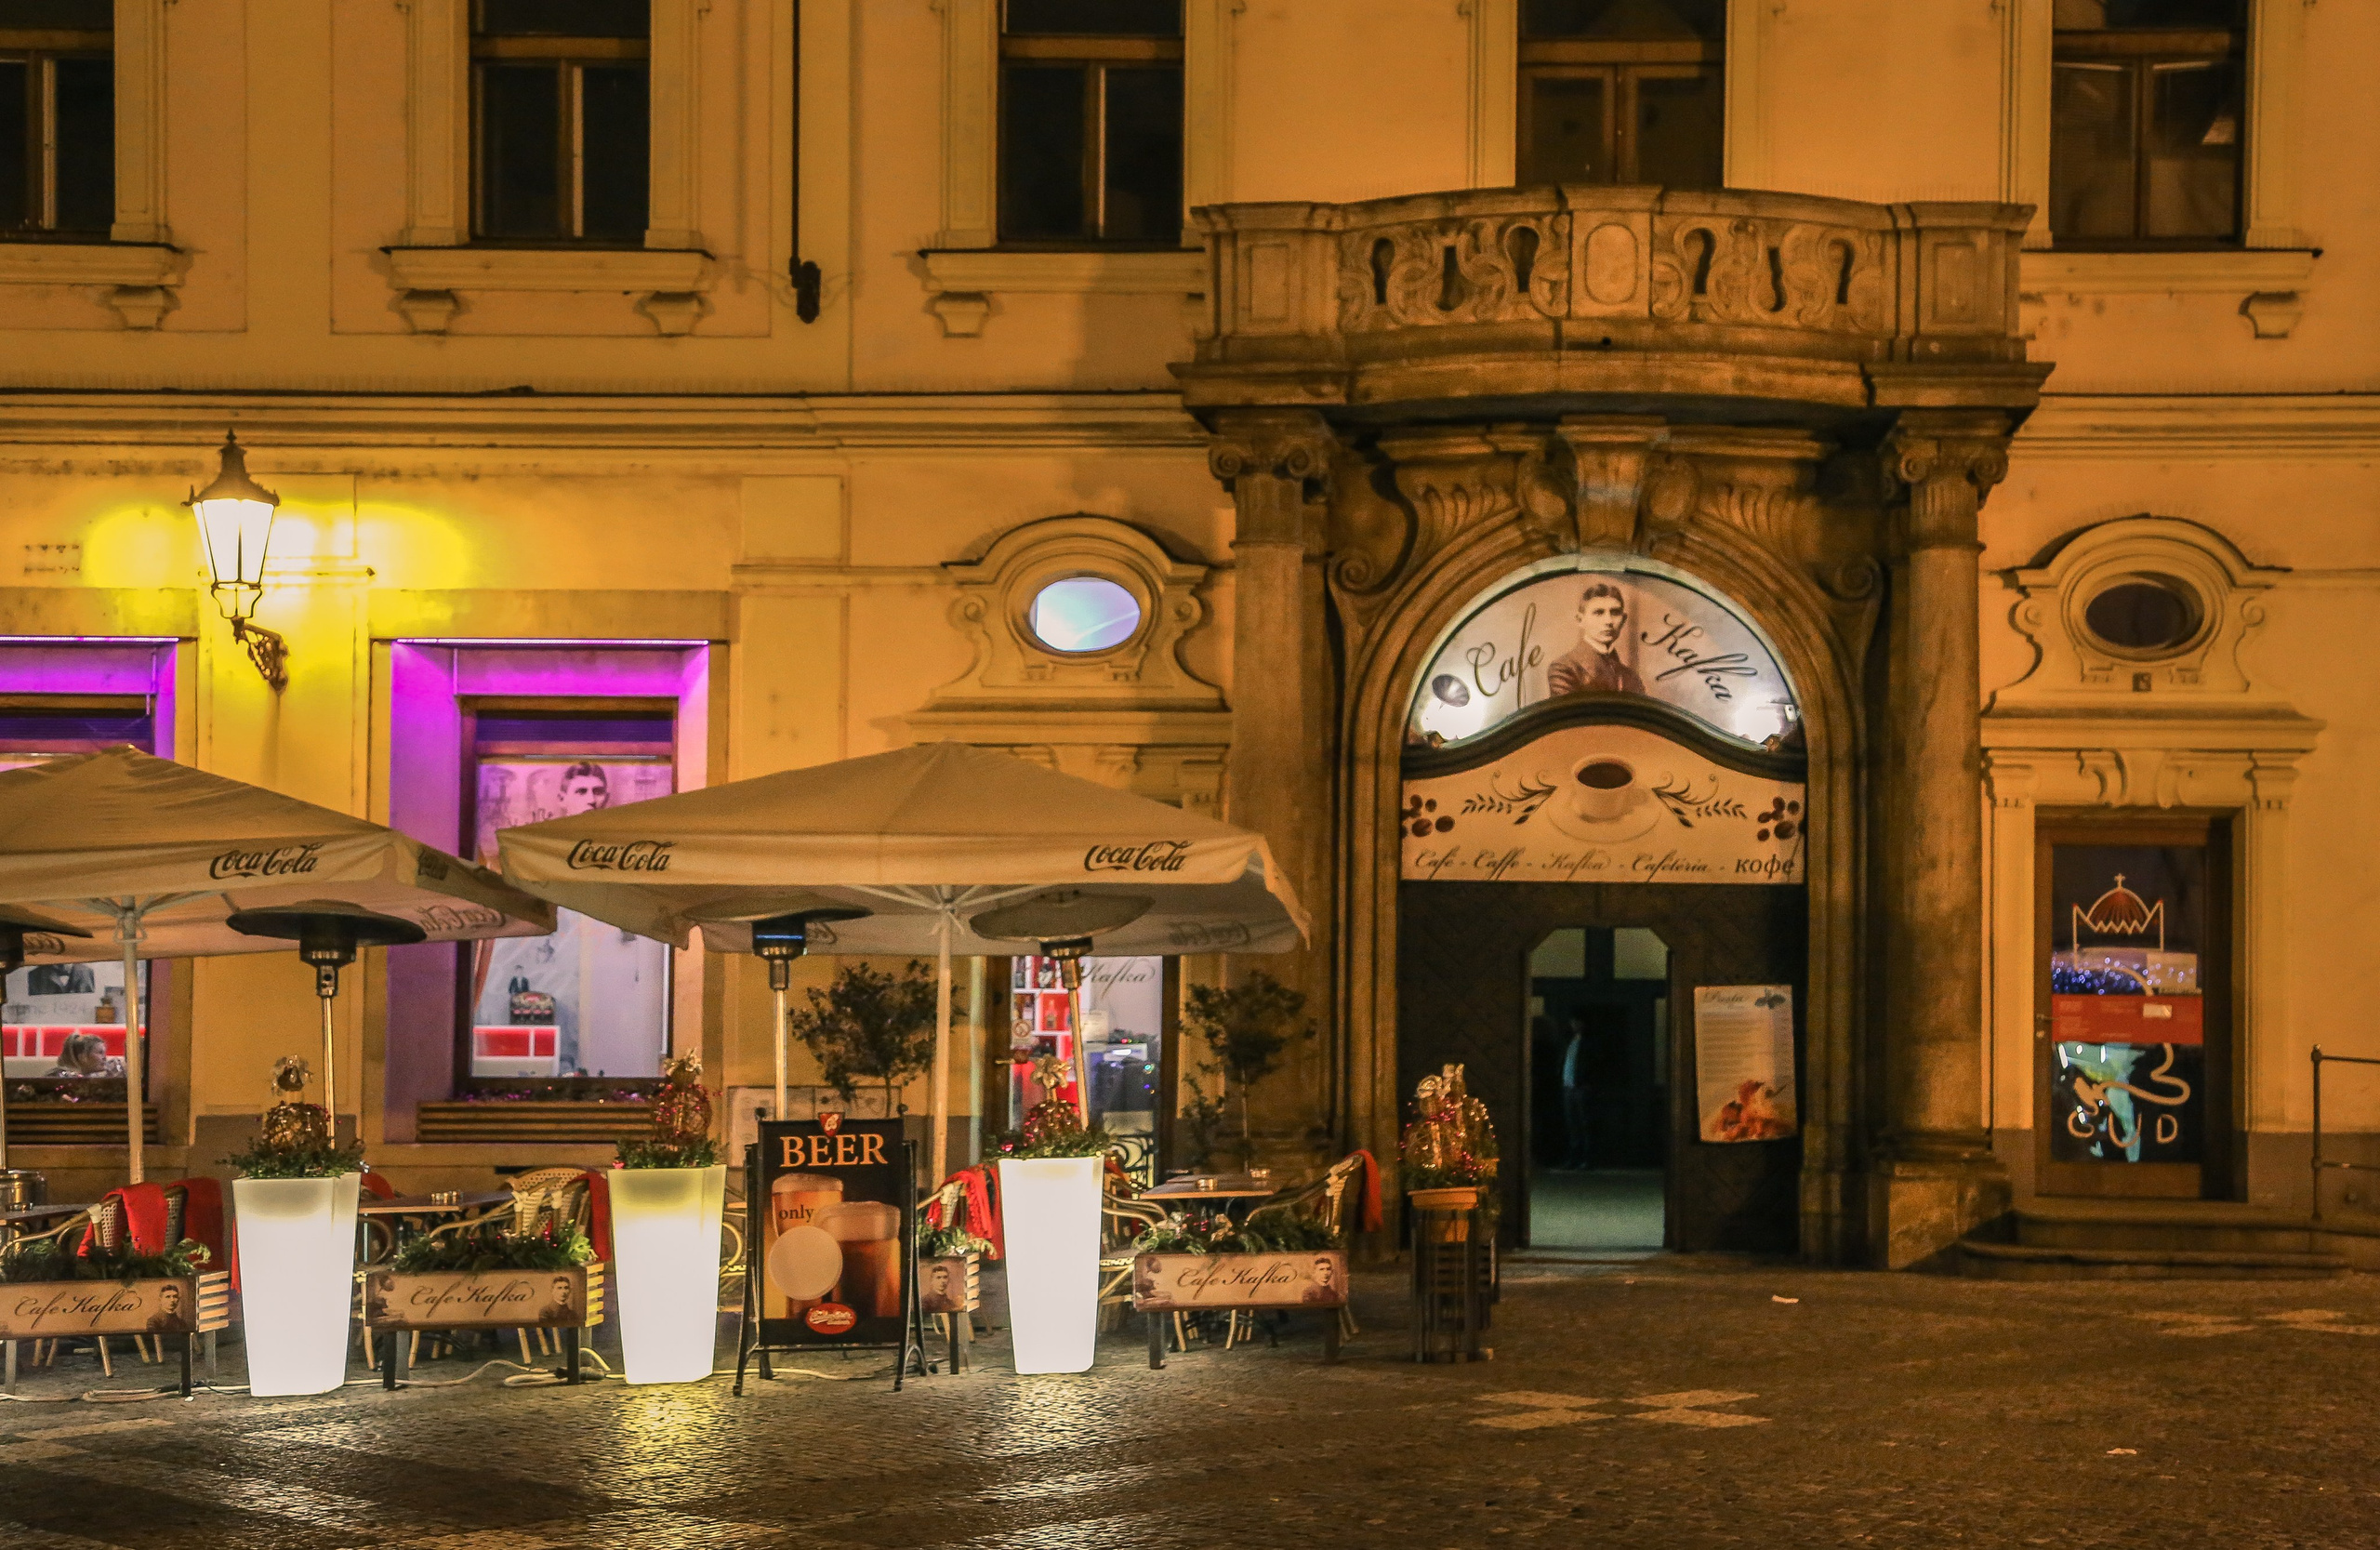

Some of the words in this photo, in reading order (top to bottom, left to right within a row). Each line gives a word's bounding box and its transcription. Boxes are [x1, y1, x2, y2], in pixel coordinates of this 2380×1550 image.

[1466, 602, 1544, 709] Cafe
[1641, 614, 1758, 701] Kafka
[209, 841, 324, 880] Coca-Cola
[566, 839, 678, 871] Coca-Cola
[1083, 840, 1196, 872] Coca-Cola
[1541, 847, 1612, 881] Kafka
[779, 1133, 889, 1168] BEER
[778, 1204, 814, 1224] only
[410, 1279, 463, 1318] Cafe
[456, 1278, 536, 1318] Kafka
[1176, 1262, 1226, 1301] Cafe
[1222, 1260, 1298, 1299] Kafka
[14, 1291, 67, 1330] Cafe
[62, 1288, 143, 1328] Kafka
